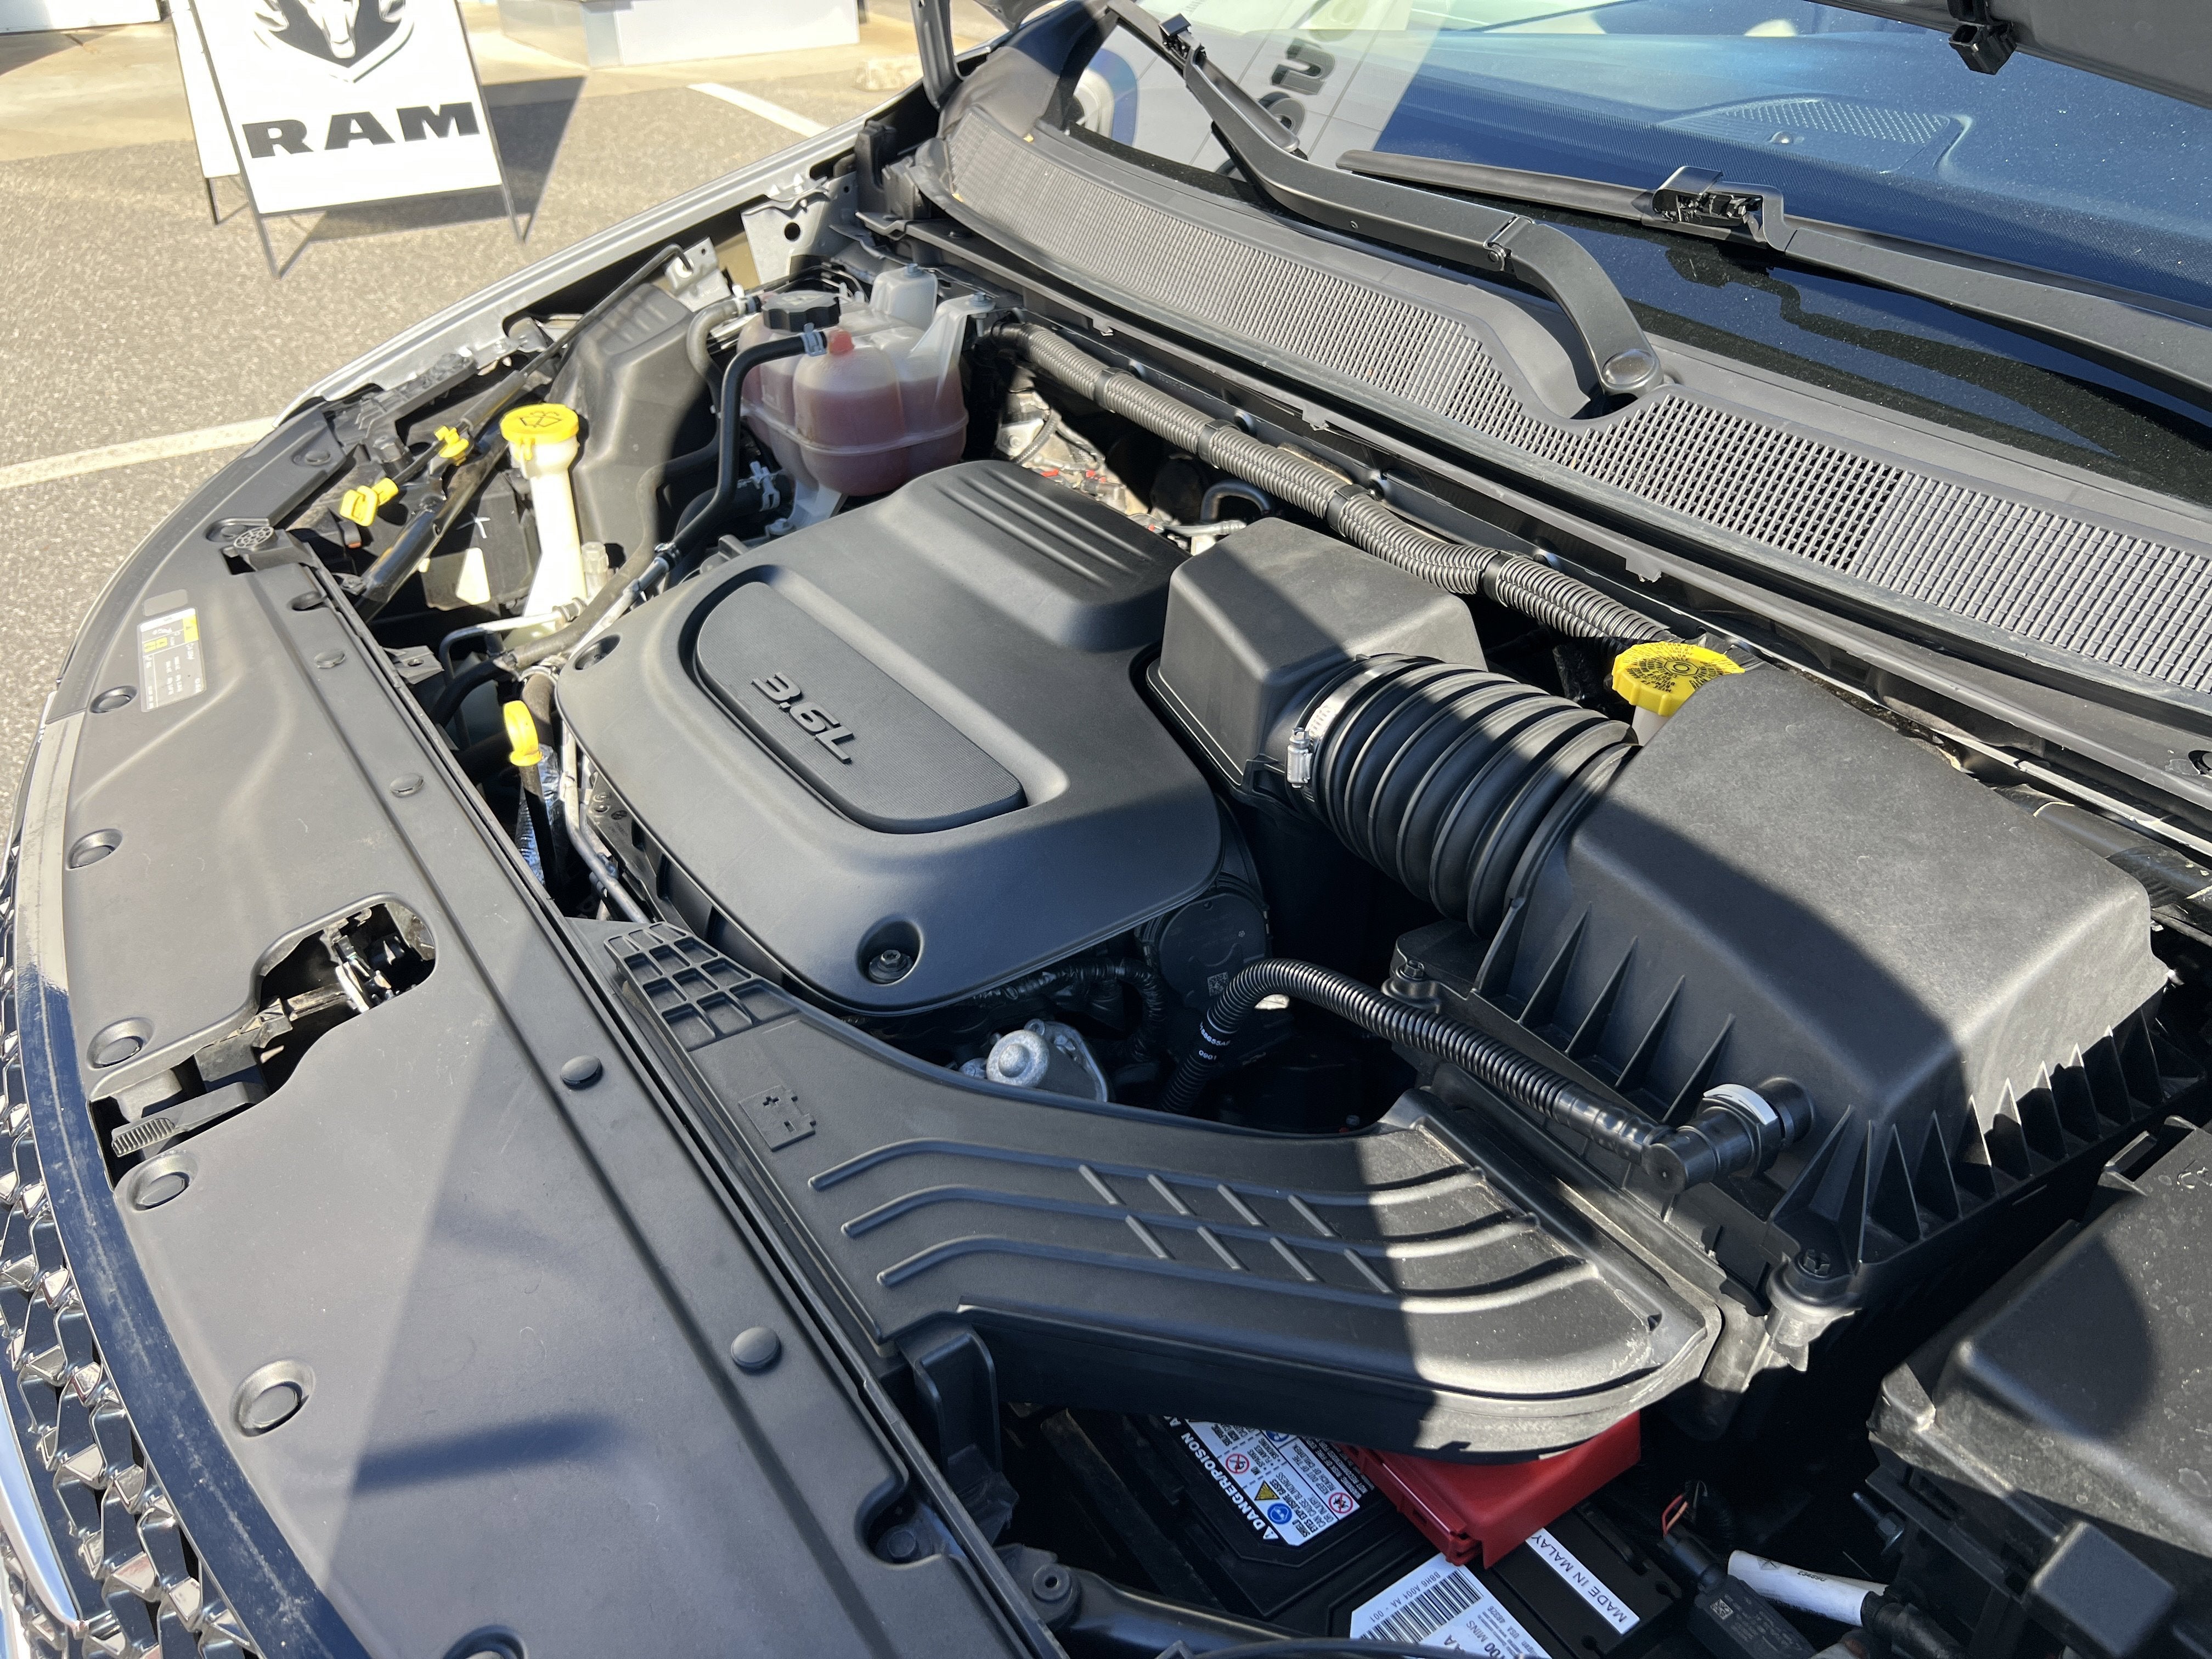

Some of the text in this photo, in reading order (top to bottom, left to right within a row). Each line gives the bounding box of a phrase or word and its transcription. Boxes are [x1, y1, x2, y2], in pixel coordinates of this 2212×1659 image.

[242, 101, 480, 159] RAM
[1653, 684, 1672, 692] MISE
[751, 672, 854, 764] 3.6L
[1246, 1448, 1266, 1468] SPARKS
[1181, 1432, 1266, 1531] DANGER/POISON
[1305, 1470, 1319, 1482] OUT
[1314, 1481, 1331, 1495] KEEP
[1273, 1471, 1327, 1528] CAN CAUSE BLINDNESS
[1530, 1532, 1628, 1623] MADE IN MALAY
[1390, 1597, 1402, 1609] AA
[1369, 1609, 1384, 1623] 001
[1464, 1619, 1488, 1643] MINS
[1506, 1625, 1520, 1639] USA
